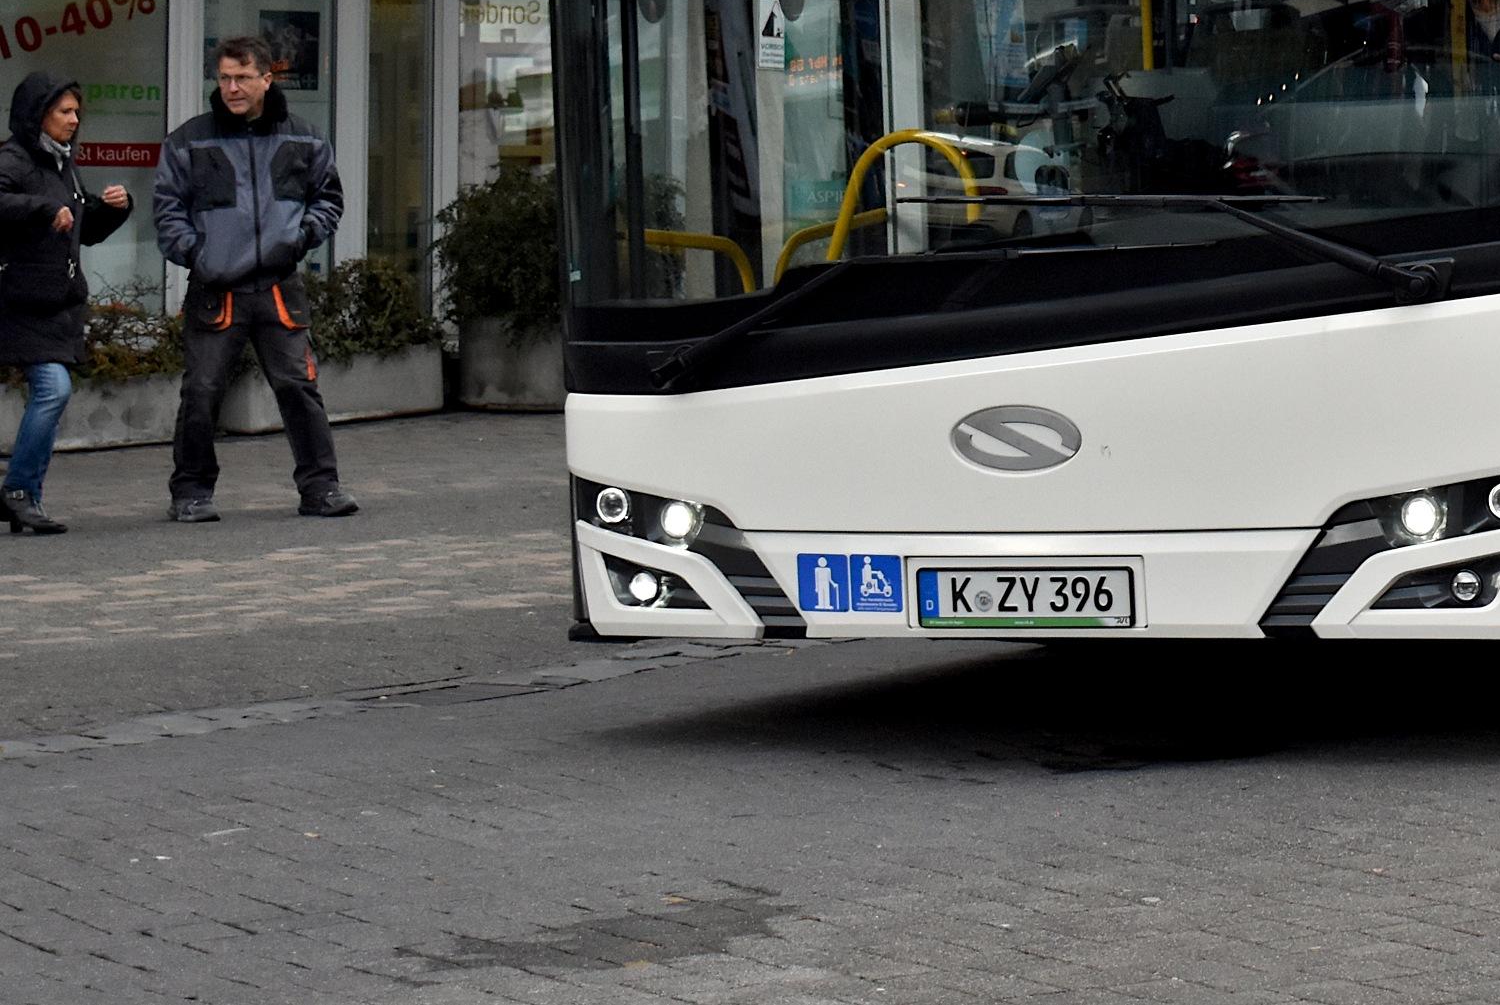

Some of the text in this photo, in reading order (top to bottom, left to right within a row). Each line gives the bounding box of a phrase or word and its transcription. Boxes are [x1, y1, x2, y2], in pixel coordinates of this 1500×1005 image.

[86, 82, 161, 100] paren
[97, 145, 151, 161] kaufen
[925, 600, 935, 611] D
[950, 576, 974, 613] K
[997, 576, 1040, 613] ZY
[1049, 575, 1114, 613] 396
